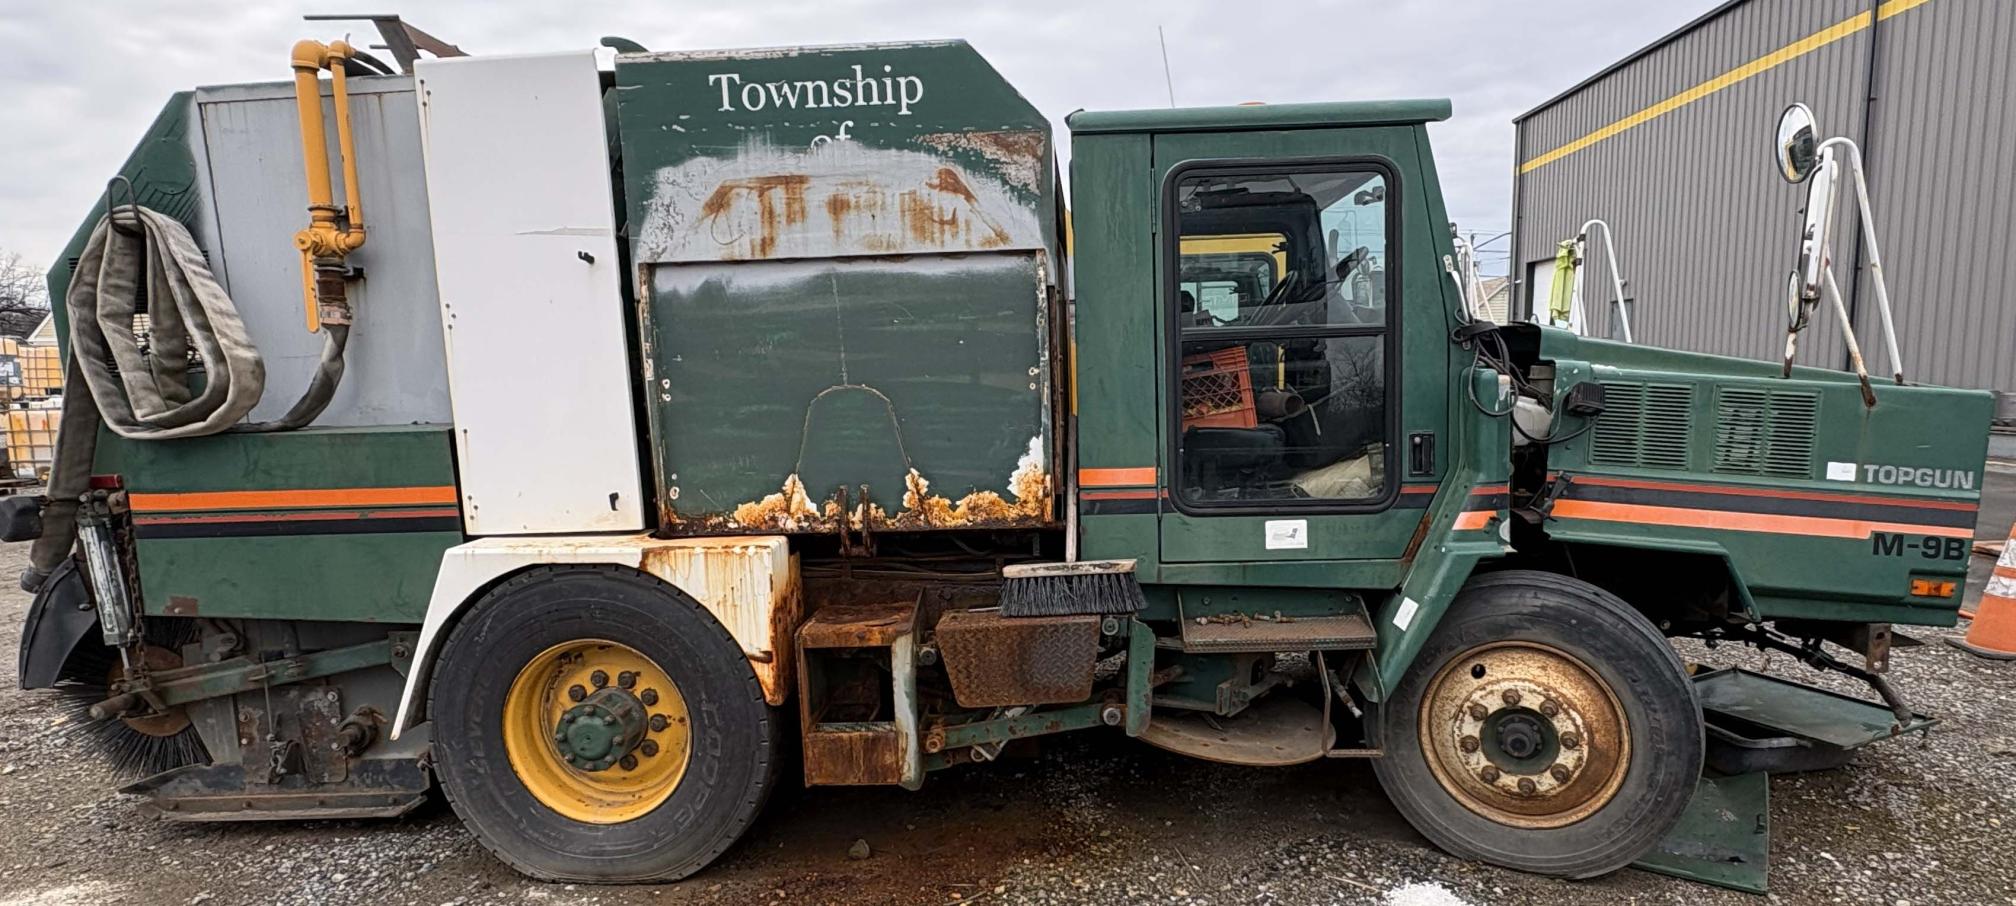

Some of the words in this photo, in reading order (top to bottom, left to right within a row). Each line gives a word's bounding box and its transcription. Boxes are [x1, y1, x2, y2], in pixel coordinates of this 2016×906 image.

[708, 64, 924, 116] Township
[1863, 464, 1975, 490] TOPGUN
[1872, 532, 1967, 562] M-9B
